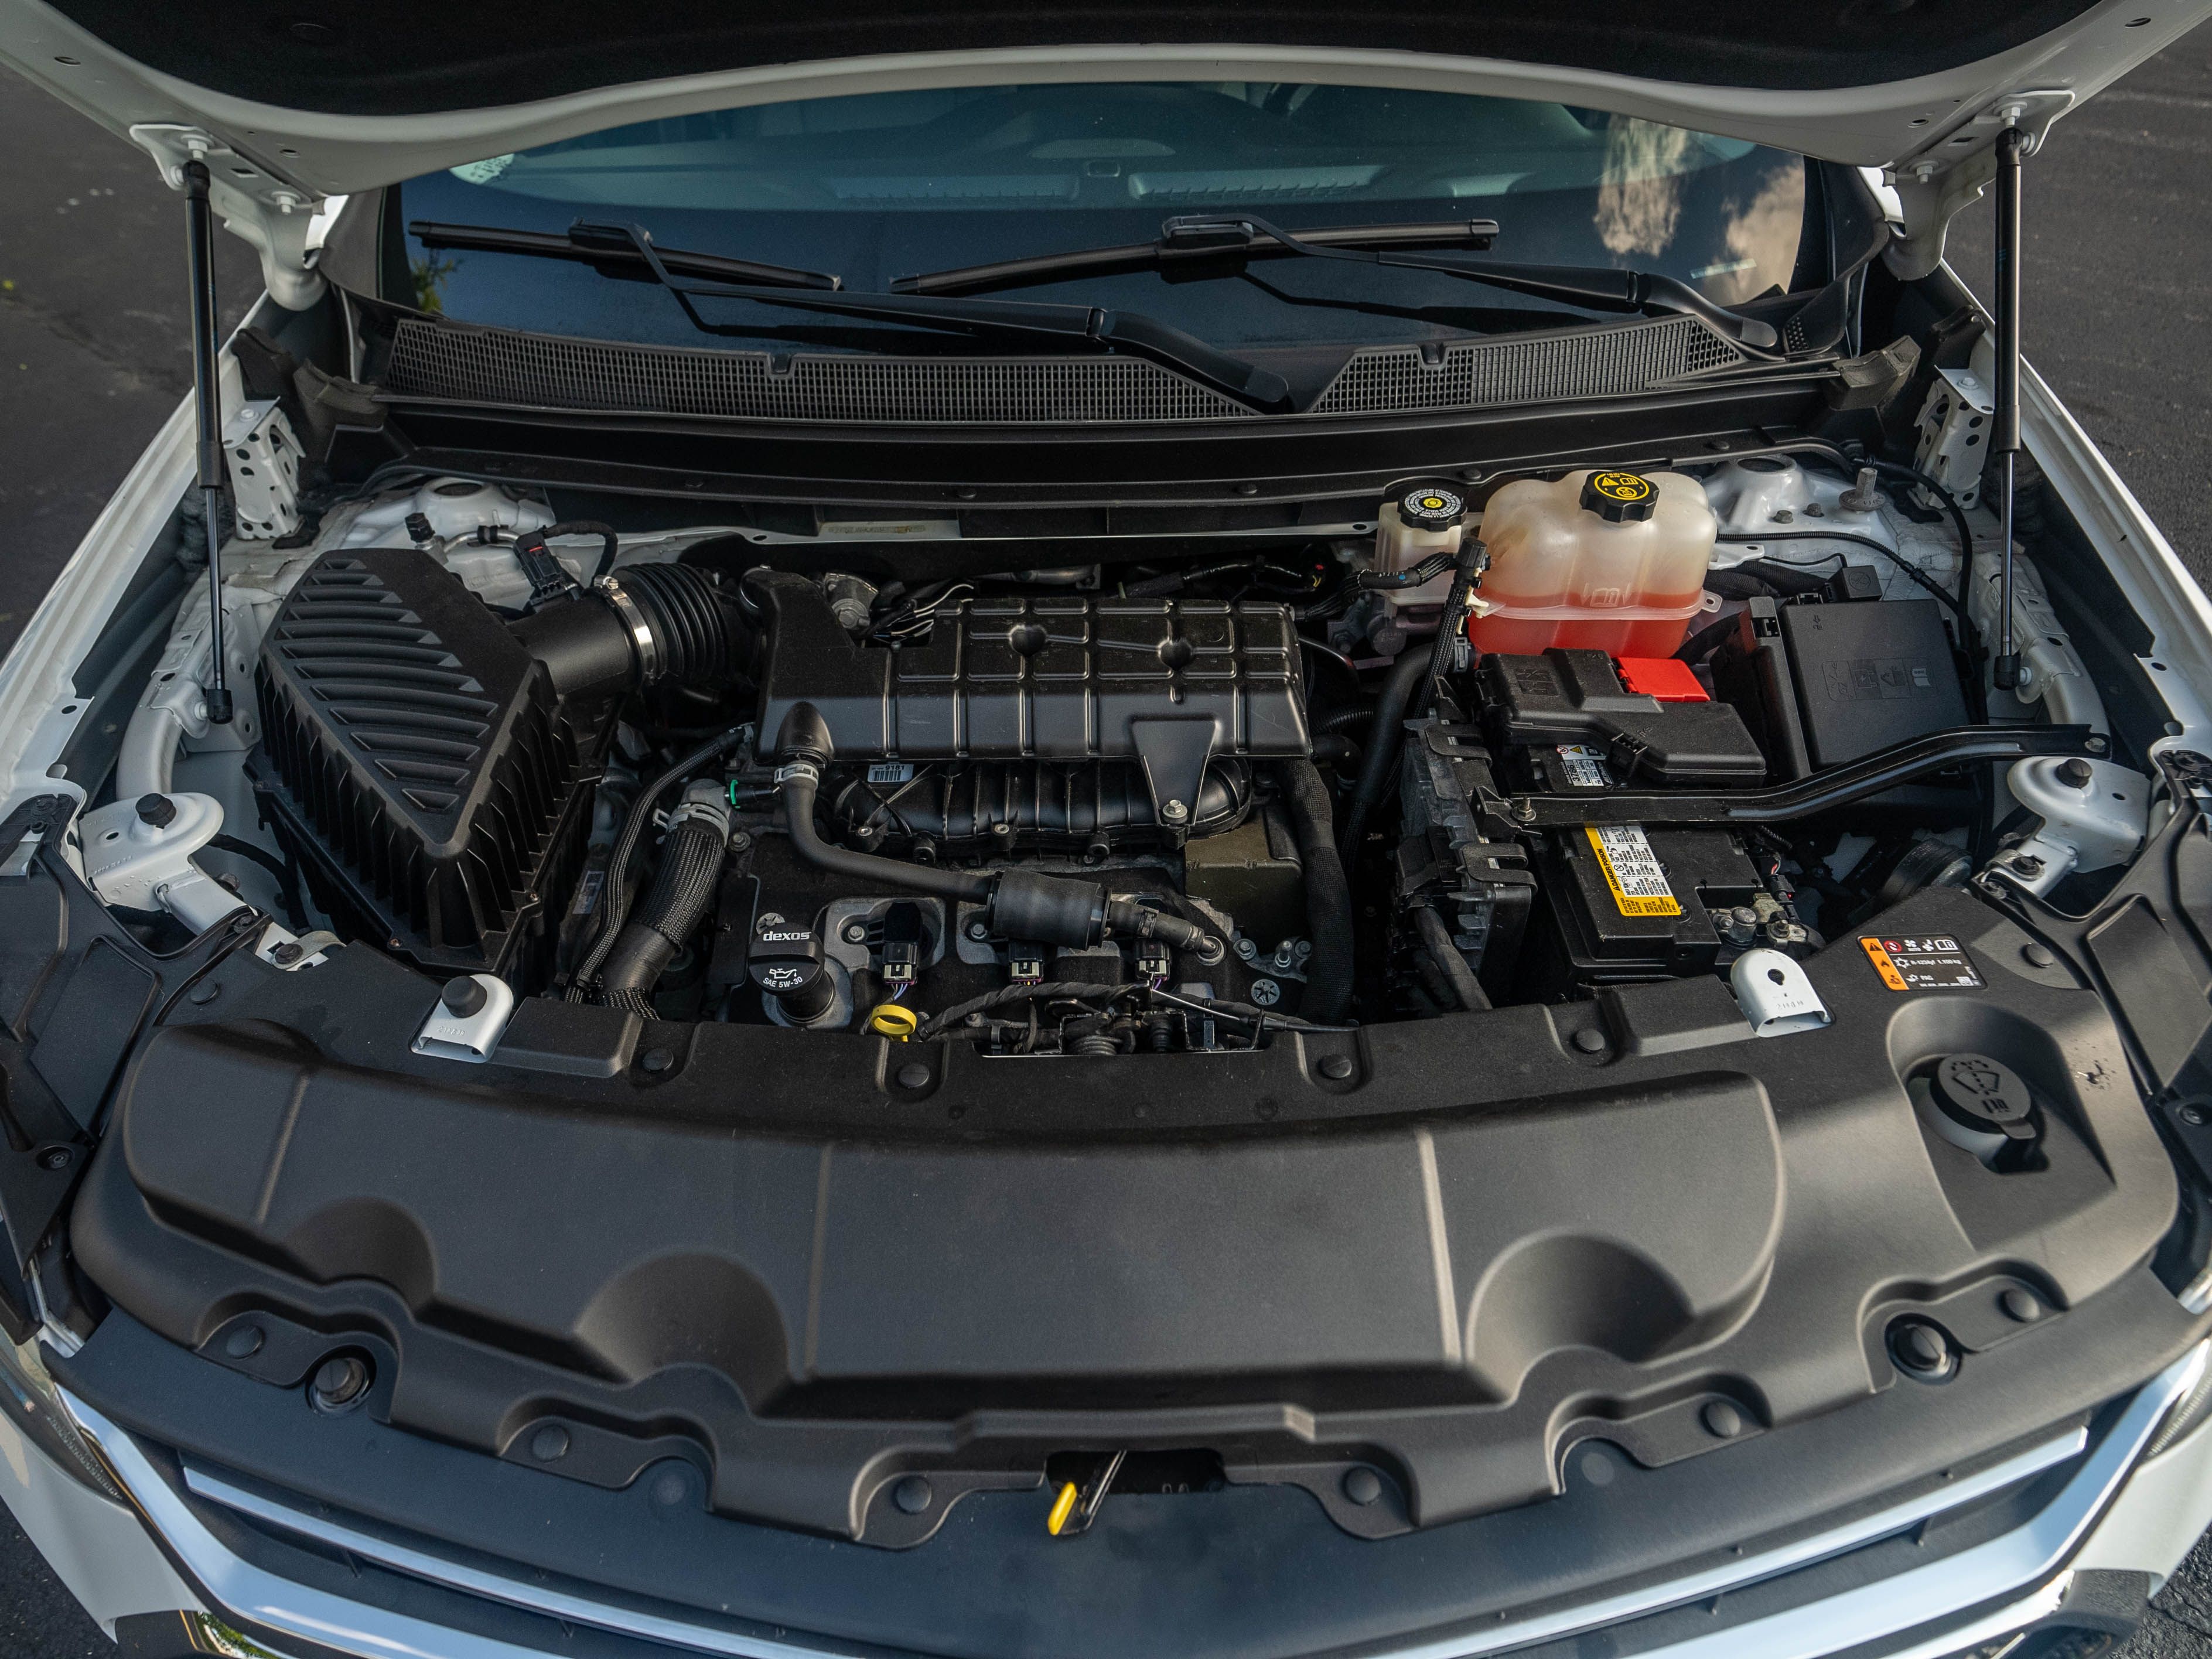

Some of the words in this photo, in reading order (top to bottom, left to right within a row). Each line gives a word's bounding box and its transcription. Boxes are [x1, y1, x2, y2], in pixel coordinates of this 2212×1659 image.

[1567, 764, 1581, 781] 3786
[1596, 848, 1619, 887] DANGER/POISON
[763, 931, 811, 941] dexos
[763, 977, 777, 987] SAE
[779, 976, 803, 988] 5W-30
